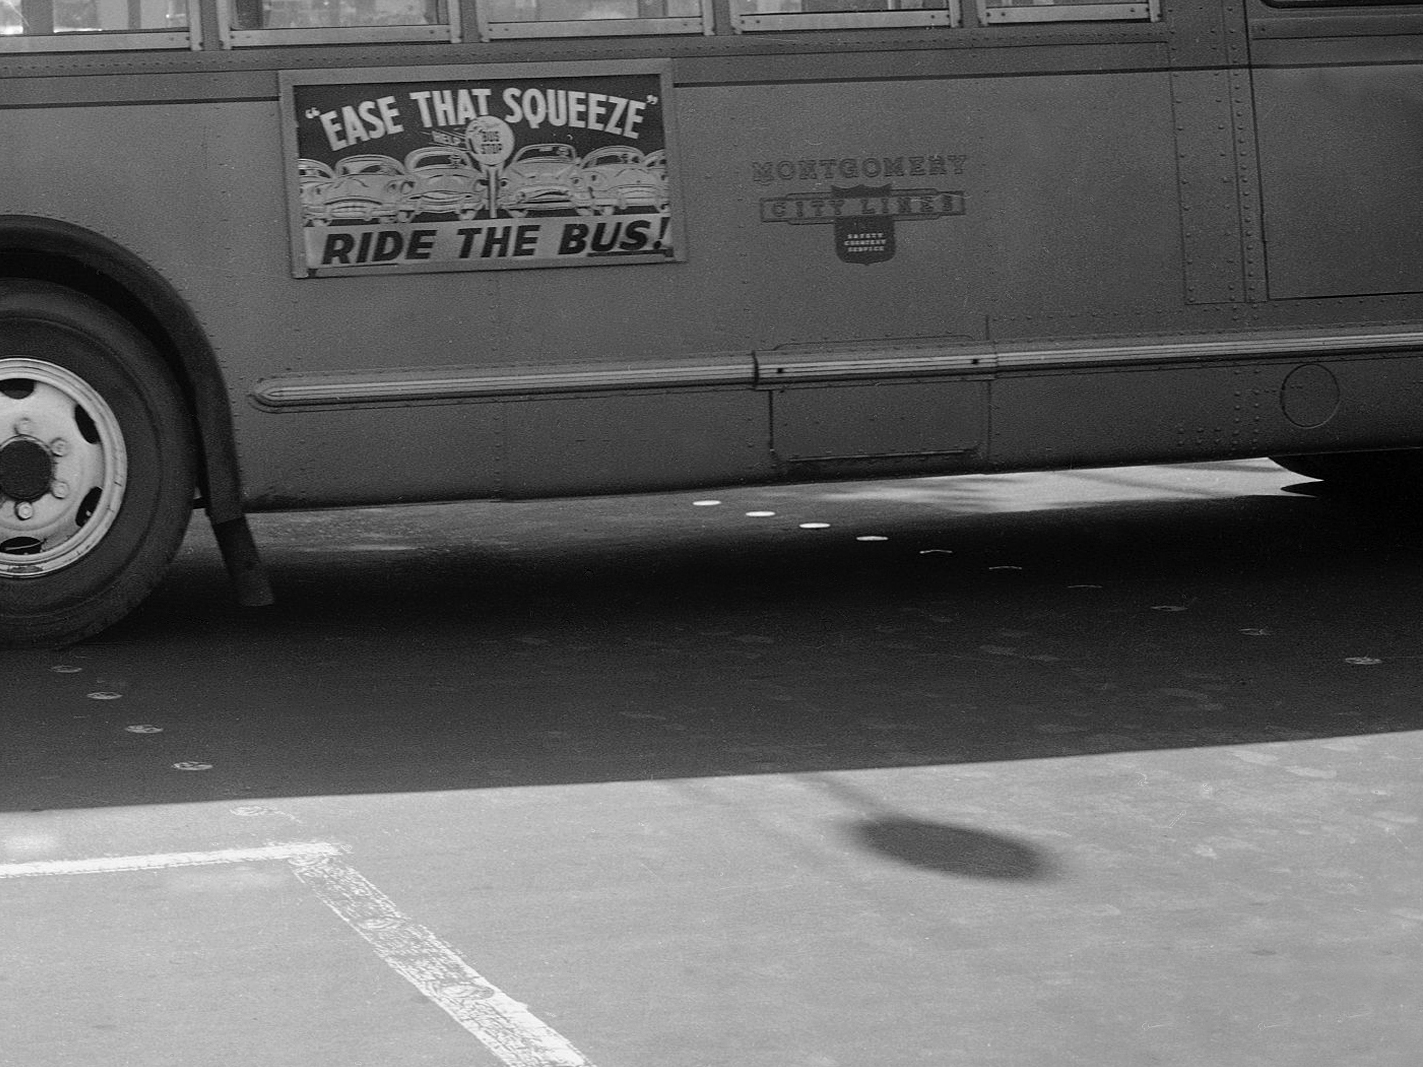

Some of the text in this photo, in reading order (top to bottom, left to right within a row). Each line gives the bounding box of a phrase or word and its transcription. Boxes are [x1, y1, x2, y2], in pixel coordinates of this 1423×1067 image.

[409, 88, 491, 128] THAT
[481, 130, 501, 143] BUS
[752, 155, 967, 182] MONTGOMERY
[773, 194, 954, 218] CITY LINES
[322, 218, 670, 264] RIDE THE BUS!
